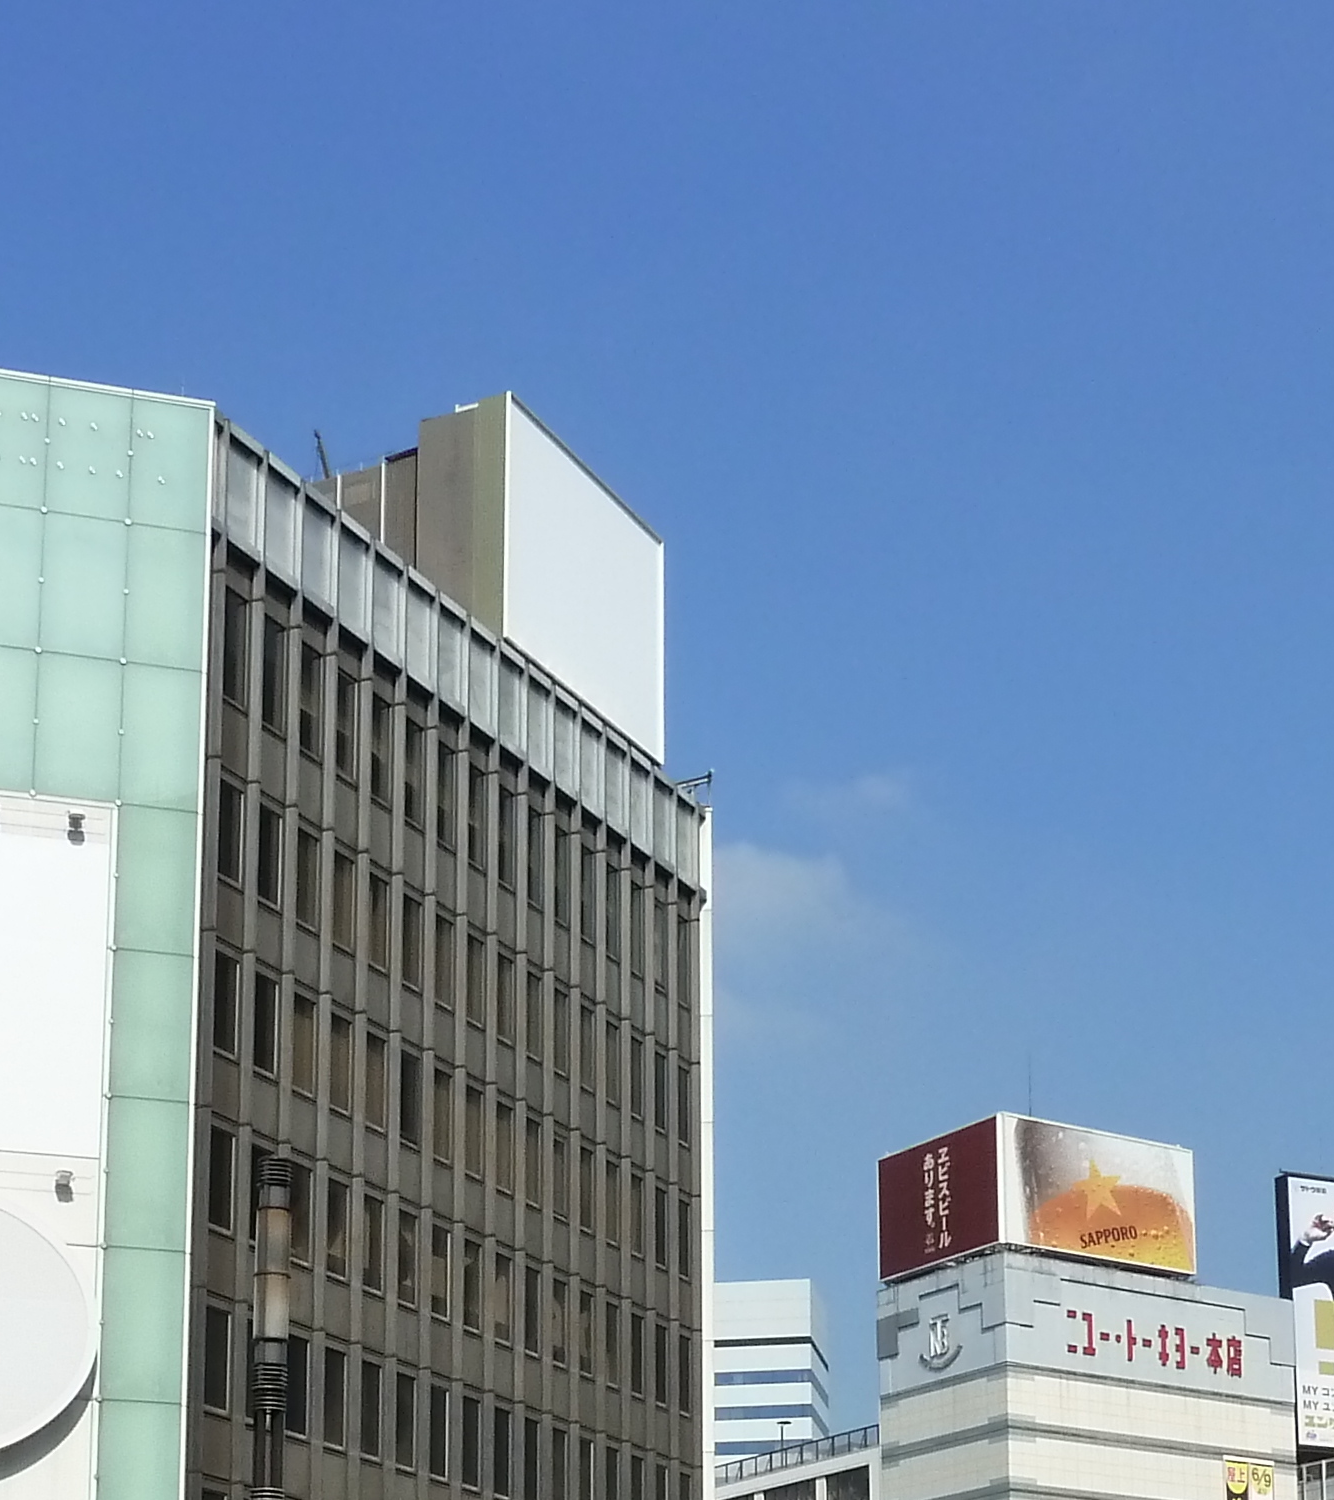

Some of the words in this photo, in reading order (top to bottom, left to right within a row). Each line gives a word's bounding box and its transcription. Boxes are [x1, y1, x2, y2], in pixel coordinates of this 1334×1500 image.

[1079, 1225, 1138, 1249] SAPPORO
[1302, 1385, 1318, 1396] MY
[1303, 1400, 1319, 1410] MY
[1251, 1467, 1272, 1488] 6/9
